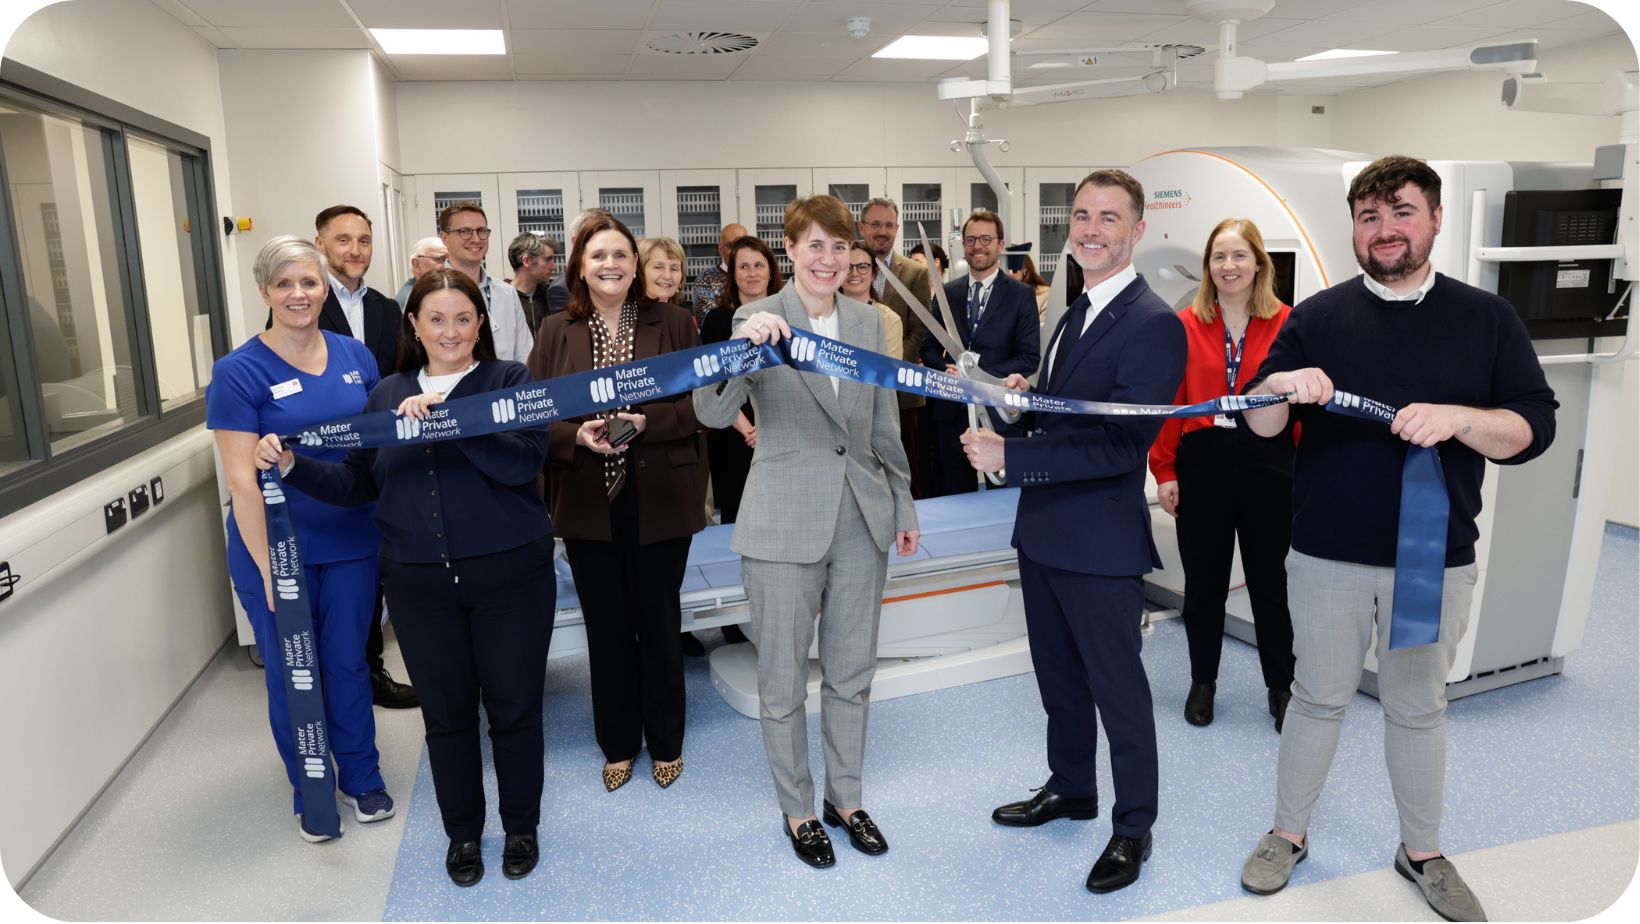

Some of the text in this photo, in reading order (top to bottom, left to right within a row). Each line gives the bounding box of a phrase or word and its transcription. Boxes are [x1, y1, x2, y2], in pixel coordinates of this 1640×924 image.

[1154, 190, 1182, 199] SIEMENS
[722, 347, 759, 364] Private
[820, 339, 855, 356] Mater
[724, 357, 766, 375] Network
[818, 349, 858, 367] Private
[615, 366, 648, 381] Mater
[816, 359, 860, 377] Network
[617, 376, 656, 392] Private
[925, 378, 965, 394] Private
[926, 370, 960, 386] Mater
[516, 387, 547, 402] Mater
[619, 385, 662, 402] Network
[924, 386, 969, 401] Network
[1032, 395, 1066, 406] Mater
[517, 398, 554, 413] Private
[425, 409, 450, 420] ater
[518, 408, 560, 424] Network
[320, 423, 351, 436] Mater
[422, 419, 458, 431] Private
[422, 427, 461, 439] Network
[269, 545, 279, 576] Mater
[277, 541, 289, 577] Private
[286, 536, 300, 576] Network
[284, 638, 295, 667] Mater
[293, 634, 305, 667] Private
[301, 630, 314, 667] Network
[297, 727, 308, 755] Mater
[307, 723, 317, 756] Private
[315, 720, 326, 756] Network
